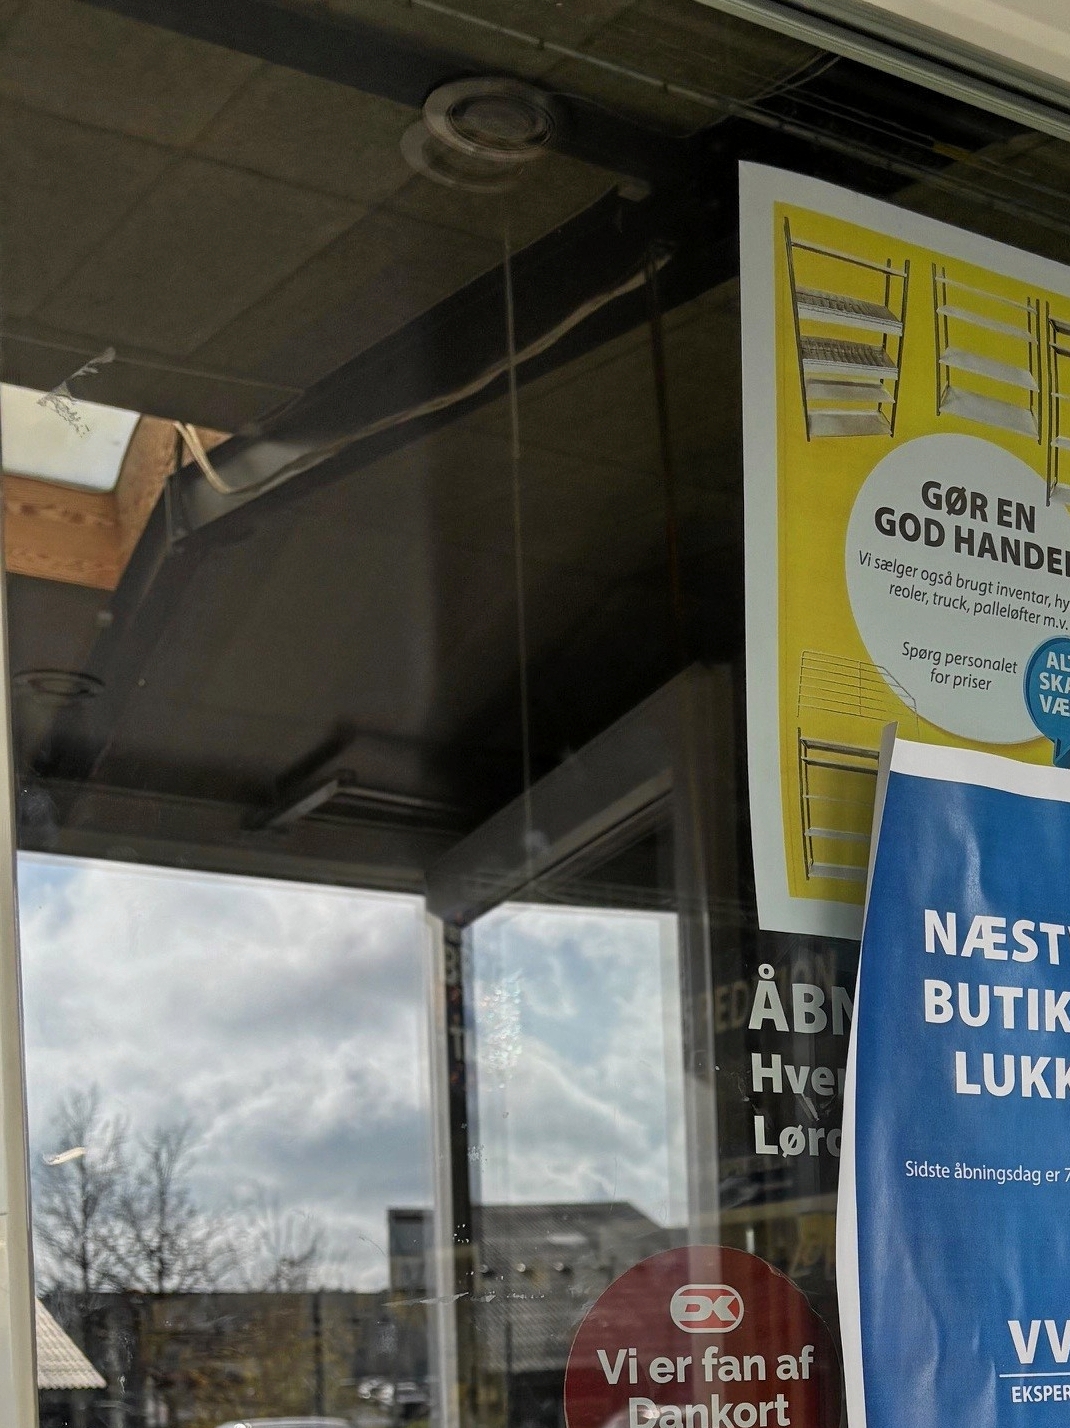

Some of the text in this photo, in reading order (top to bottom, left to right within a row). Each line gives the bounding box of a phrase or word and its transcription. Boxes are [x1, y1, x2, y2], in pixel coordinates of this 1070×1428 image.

[875, 507, 945, 547] GOD
[922, 481, 1035, 533] GØR EN
[859, 550, 871, 566] Vi
[874, 557, 918, 578] sælger
[921, 569, 952, 586] også
[957, 574, 993, 597] brugt
[996, 582, 1051, 607] inventar,
[890, 583, 1068, 630] reoler, truck, palleløfter m.v.
[902, 642, 1017, 674] Spørg personalet
[931, 668, 992, 690] for priser
[906, 1160, 950, 1178] Sidste
[954, 1162, 1040, 1185] åbningsdag
[1046, 1168, 1060, 1182] er
[597, 1345, 814, 1385] Vi er fan af
